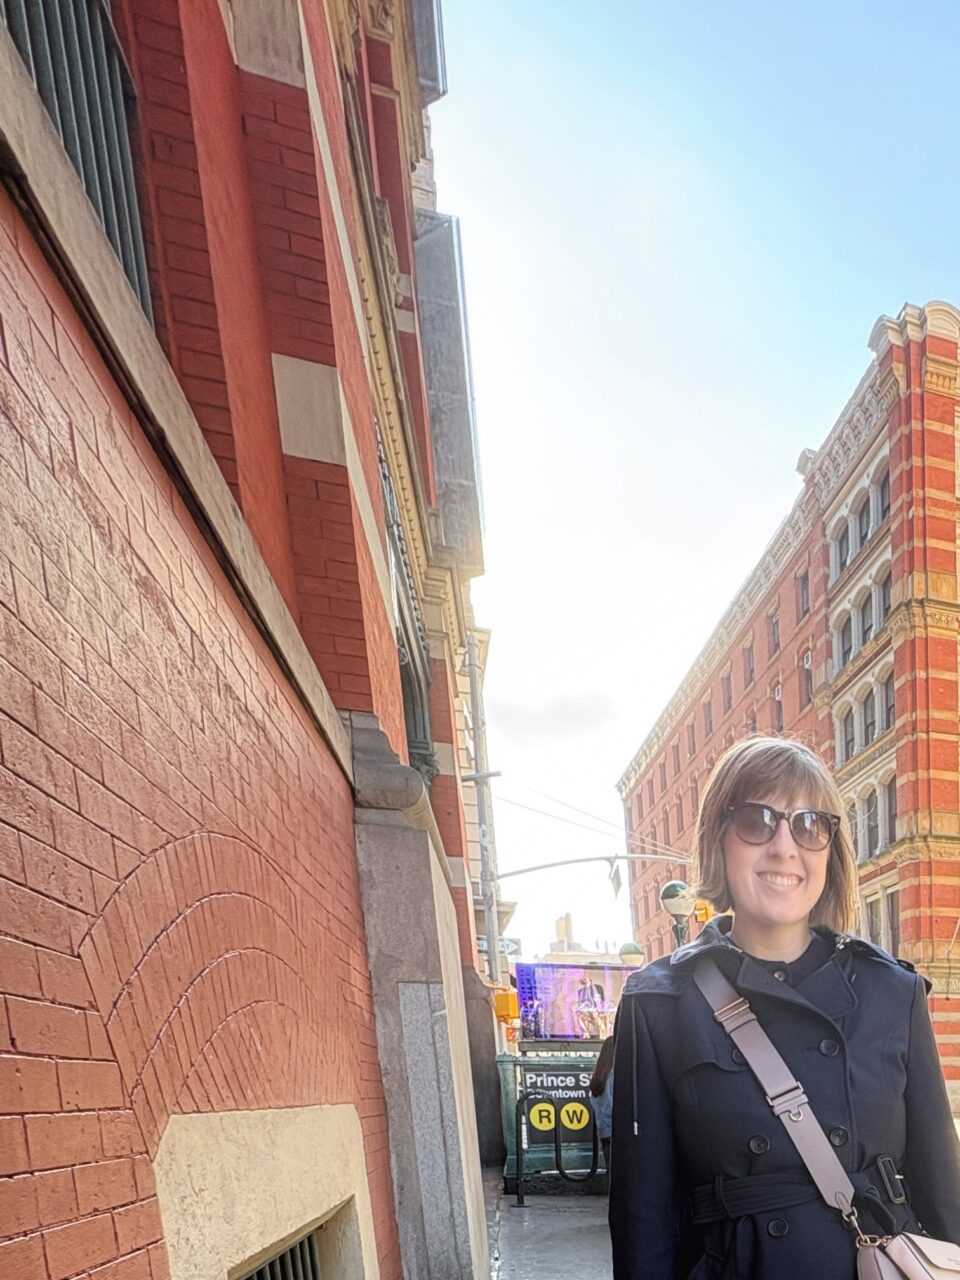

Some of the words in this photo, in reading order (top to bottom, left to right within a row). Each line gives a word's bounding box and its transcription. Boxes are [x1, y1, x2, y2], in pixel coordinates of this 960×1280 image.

[525, 1073, 575, 1087] Prince
[538, 1109, 552, 1124] R
[565, 1109, 584, 1124] W
